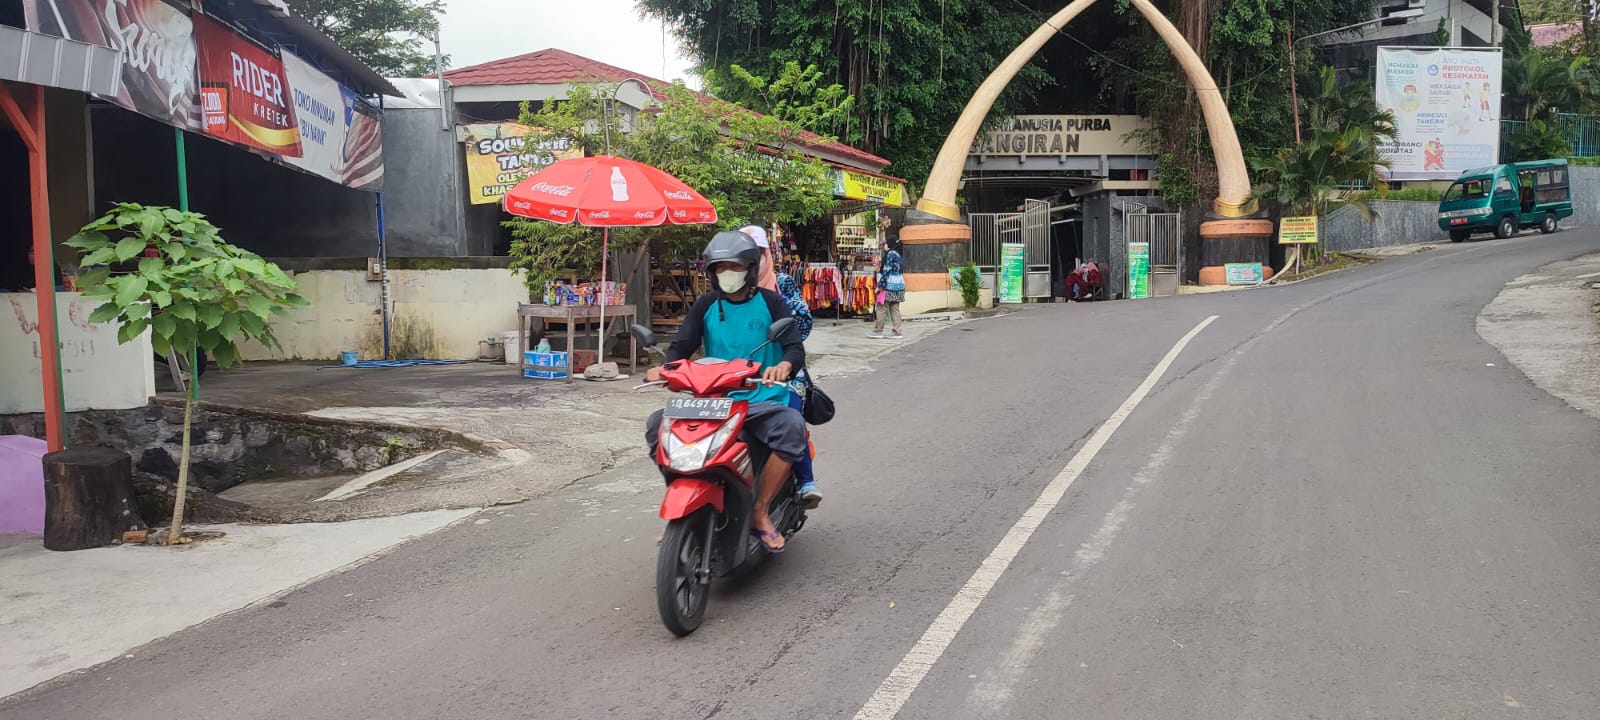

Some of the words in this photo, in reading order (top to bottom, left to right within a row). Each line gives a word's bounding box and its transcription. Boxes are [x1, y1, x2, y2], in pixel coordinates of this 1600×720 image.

[1442, 65, 1486, 73] PROTOKOL
[231, 52, 286, 108] RIDER
[294, 88, 311, 112] TOKO
[253, 102, 289, 127] KRETEK
[1066, 119, 1111, 131] PURBA
[683, 399, 710, 409] 6497
[710, 399, 731, 410] APE
